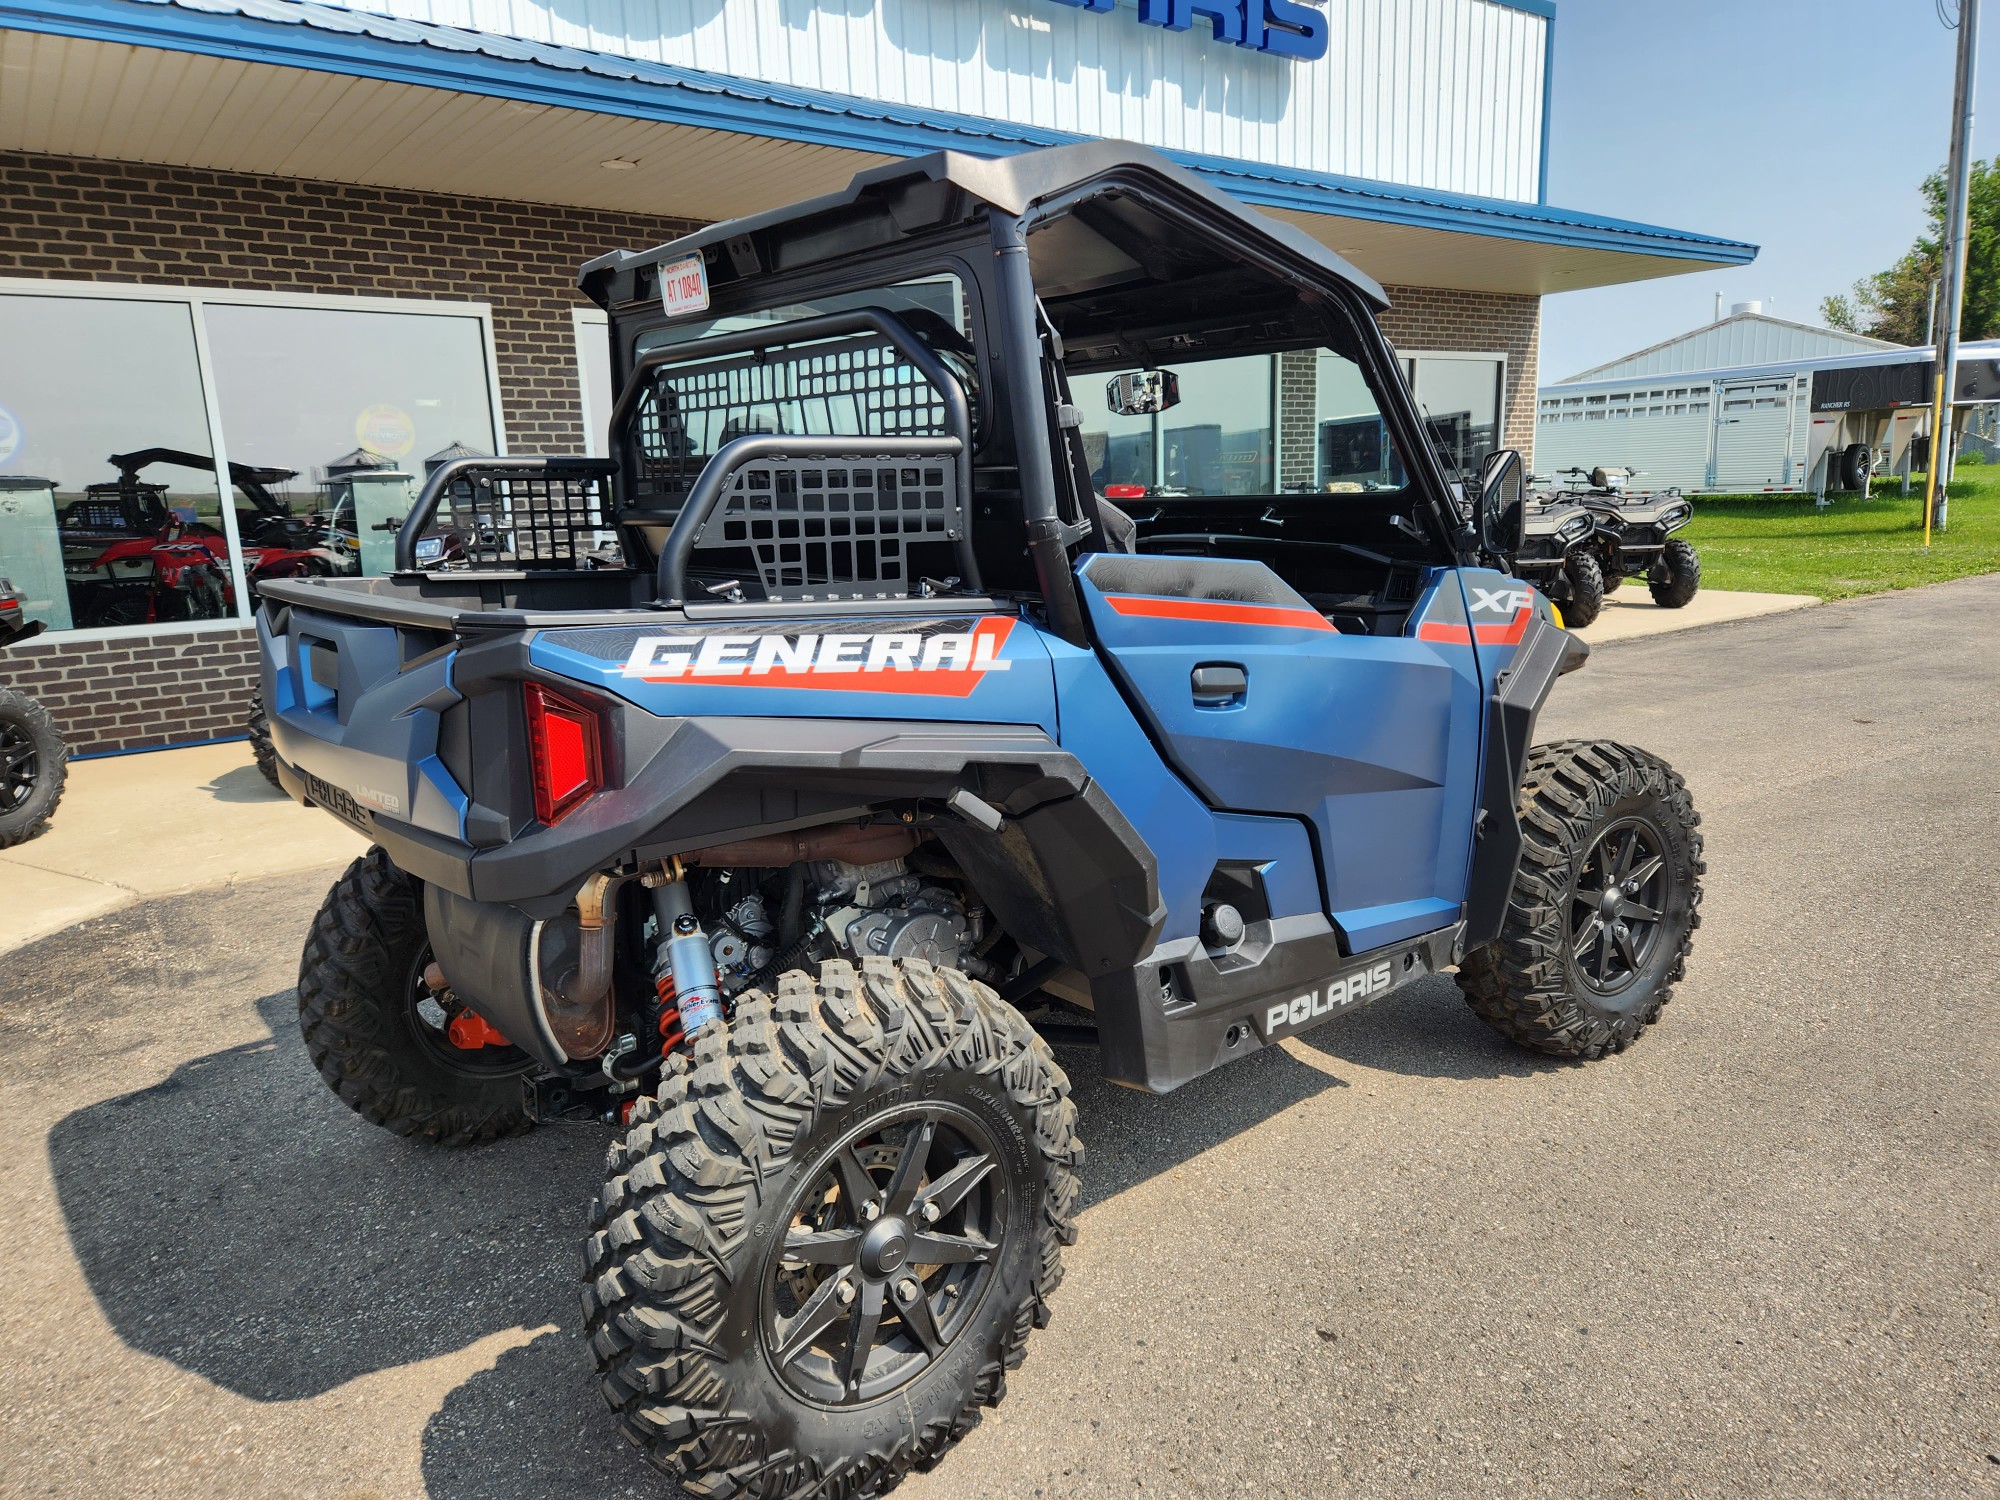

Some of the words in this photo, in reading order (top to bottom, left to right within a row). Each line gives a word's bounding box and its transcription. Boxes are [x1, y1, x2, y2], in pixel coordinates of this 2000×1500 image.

[667, 280, 677, 303] AT
[678, 273, 702, 300] 10840
[1820, 401, 1843, 409] RANCHER
[150, 543, 205, 551] CRF
[1469, 588, 1533, 613] XP
[621, 632, 1012, 679] GENERAL
[310, 774, 367, 826] POLARIS
[356, 783, 399, 807] LIMITED
[1266, 961, 1391, 1036] POLARIS
[838, 1083, 914, 1135] ARMOR
